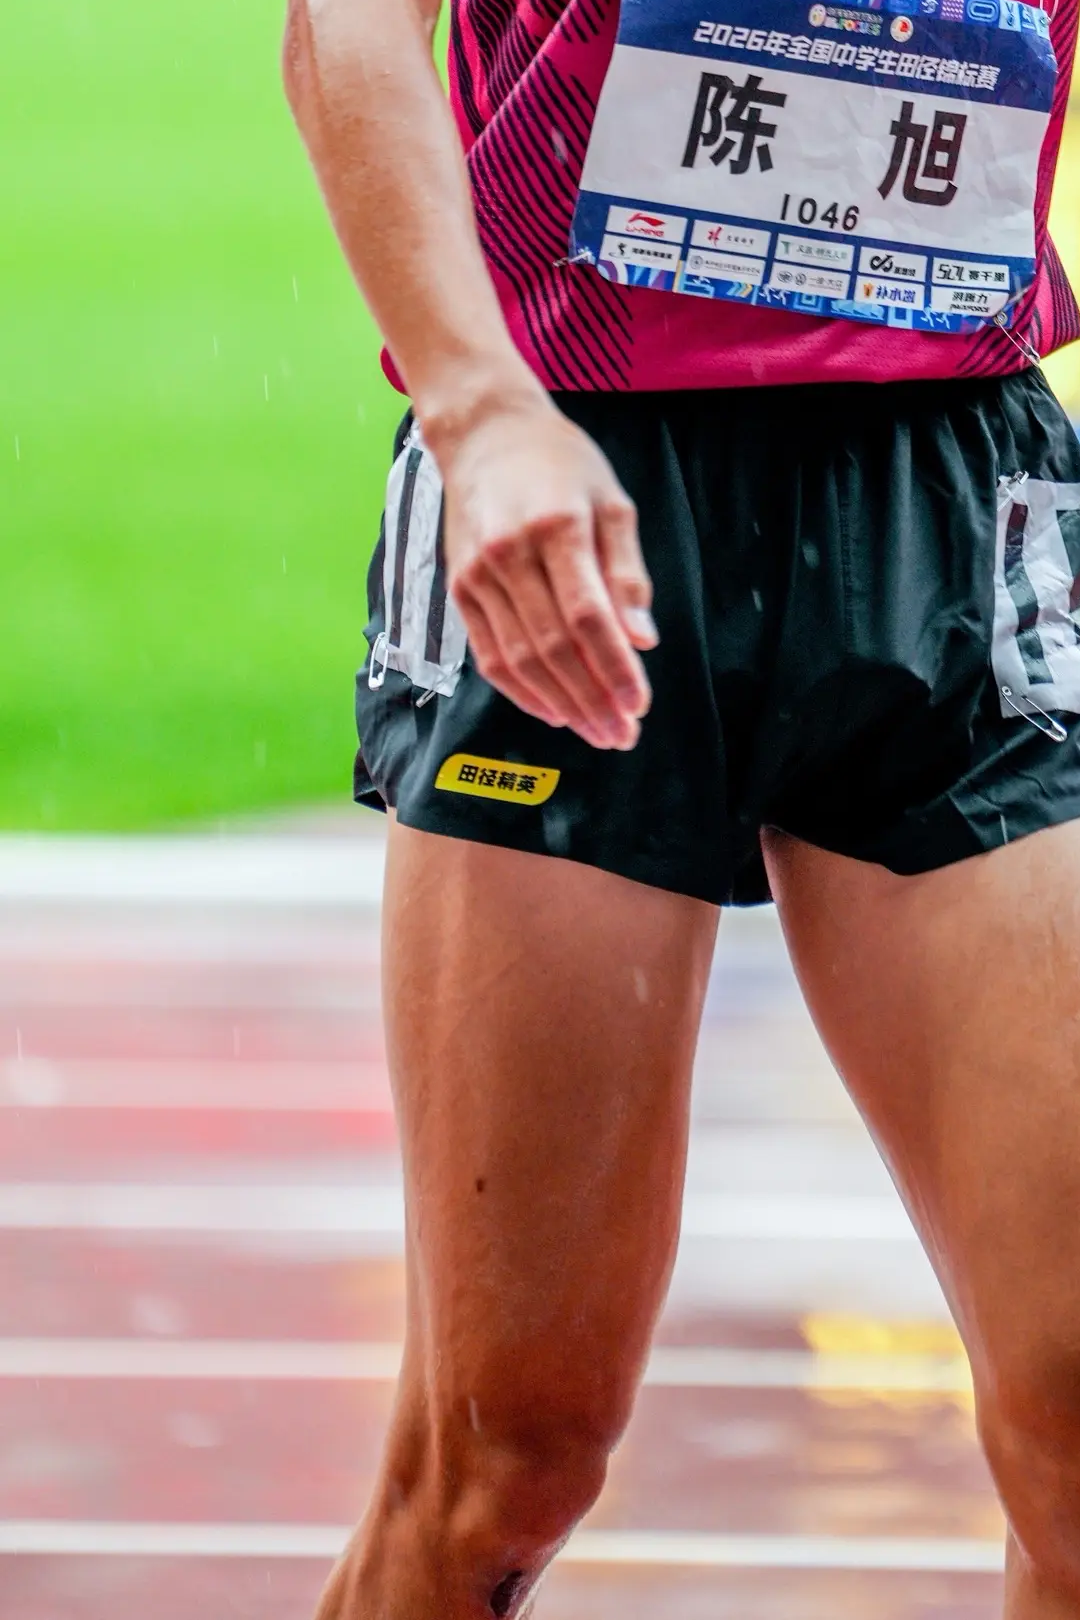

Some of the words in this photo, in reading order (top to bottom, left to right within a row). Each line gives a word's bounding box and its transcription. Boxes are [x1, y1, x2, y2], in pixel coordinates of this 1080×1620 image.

[693, 21, 1001, 92] 2026年全国中学生田径锦标赛
[681, 70, 788, 176] 陈
[877, 100, 968, 207] 旭
[780, 193, 860, 232] 1046
[458, 763, 539, 794] 田径精英
